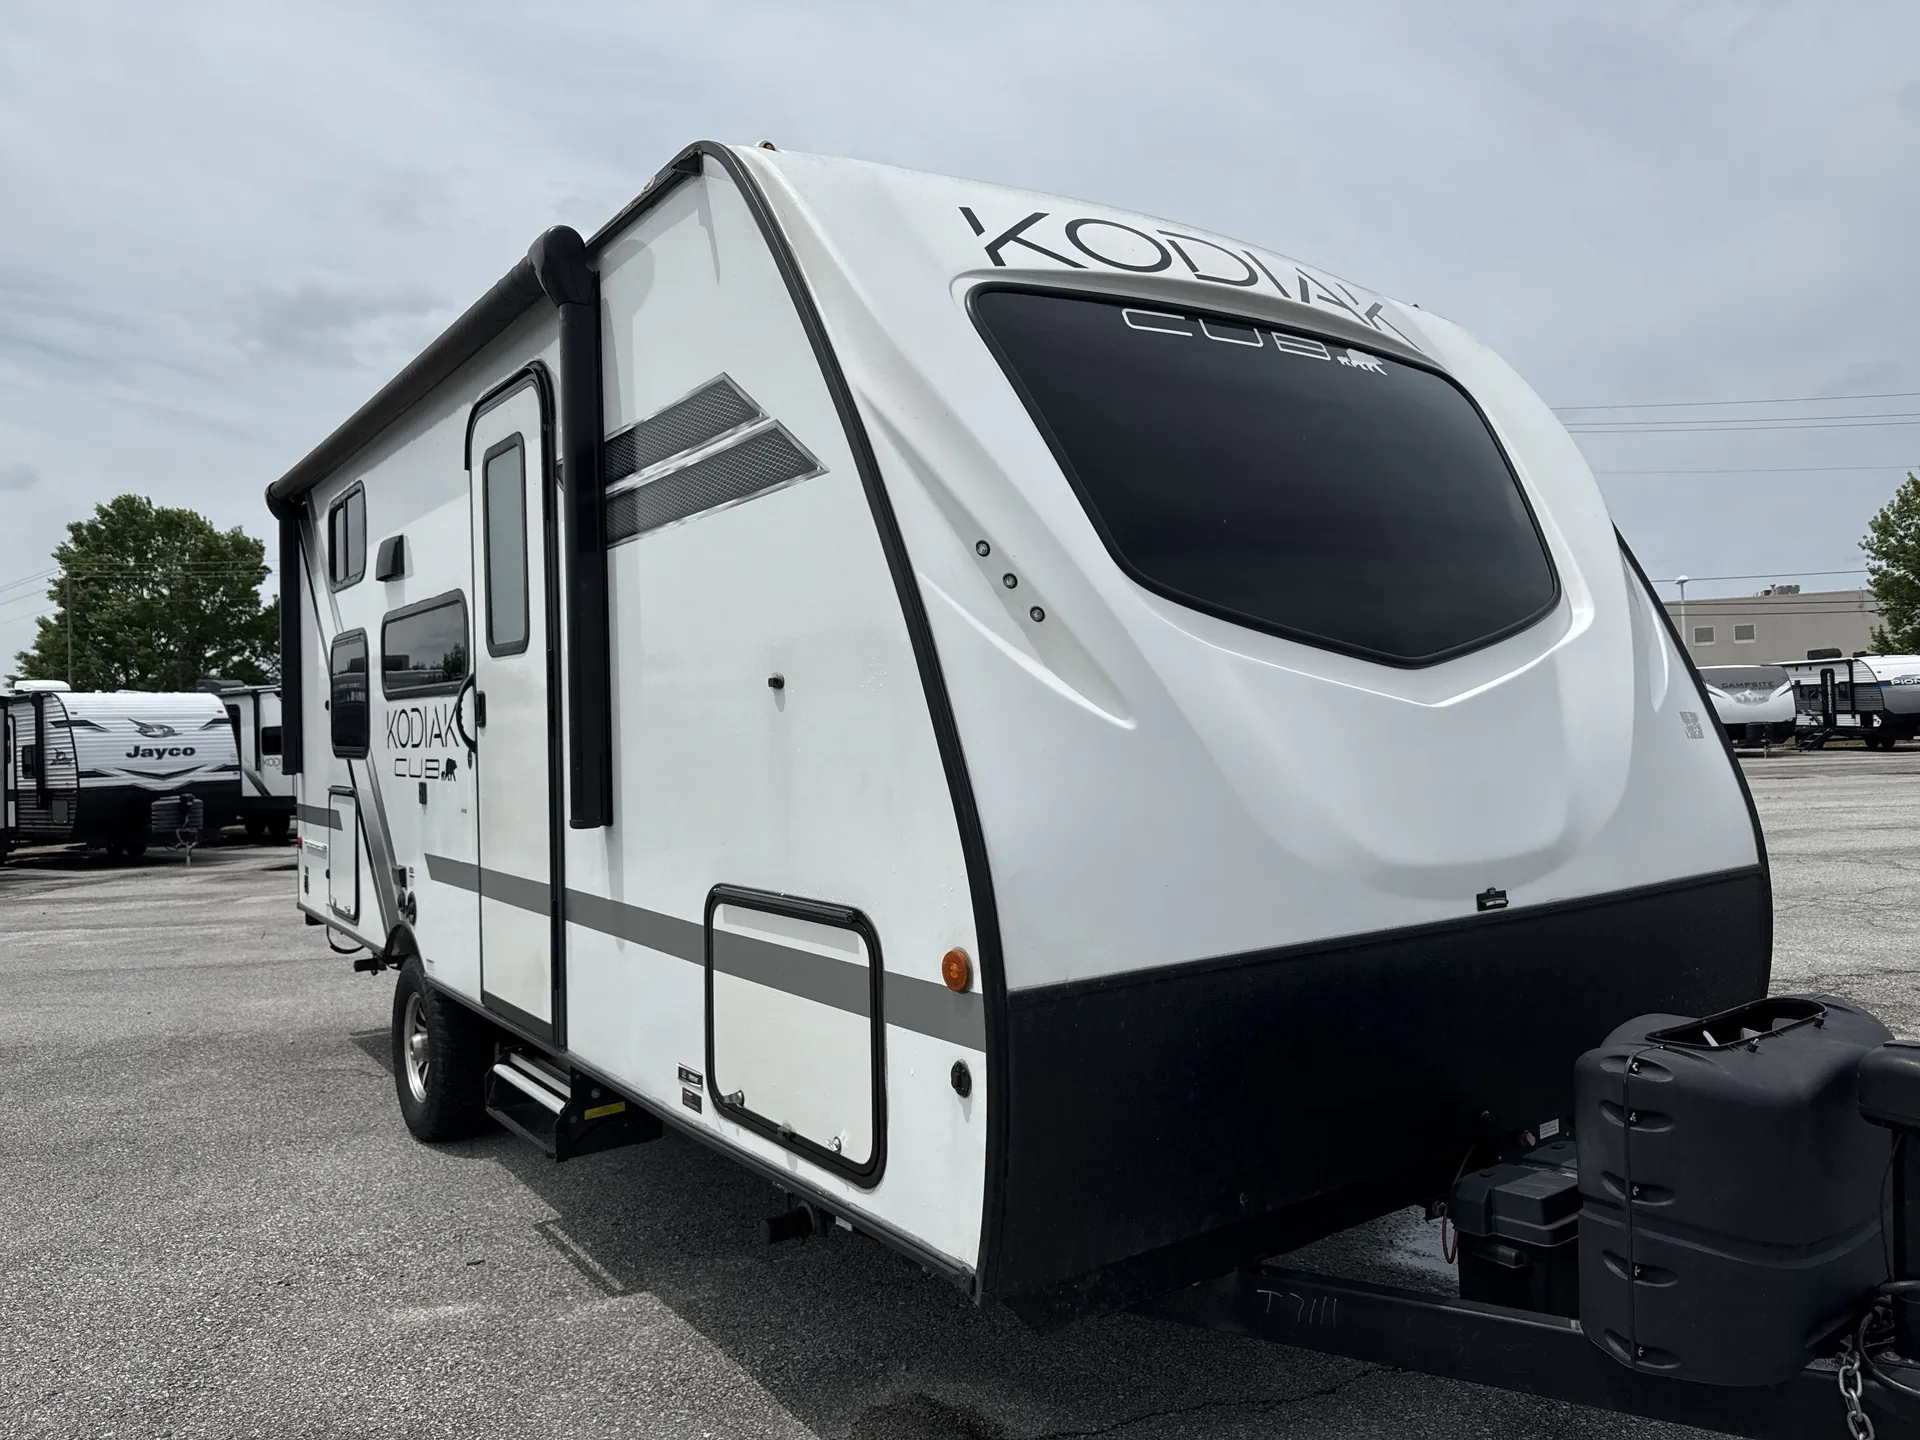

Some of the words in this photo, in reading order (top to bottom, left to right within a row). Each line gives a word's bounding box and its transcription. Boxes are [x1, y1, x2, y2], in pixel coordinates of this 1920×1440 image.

[959, 207, 1424, 352] KODIAK
[1122, 308, 1331, 361] CUB
[1721, 681, 1774, 689] CAMPSITE
[386, 703, 459, 749] KODIAK
[125, 745, 196, 760] Jayco
[394, 758, 440, 779] CUB
